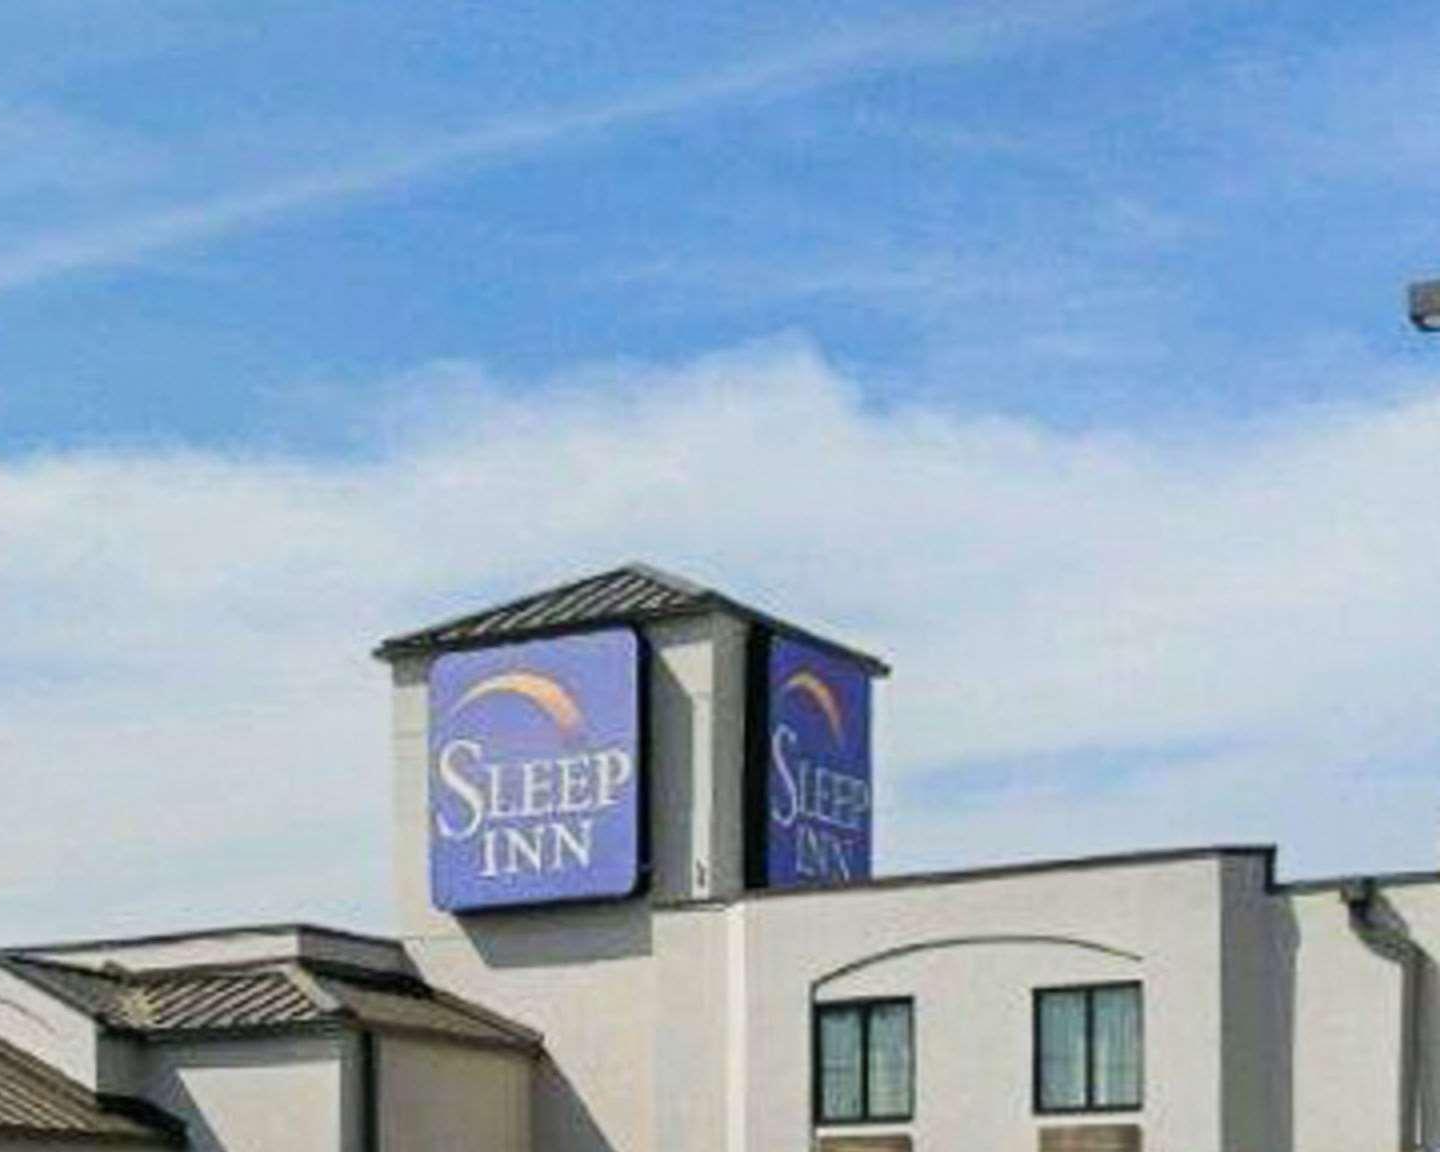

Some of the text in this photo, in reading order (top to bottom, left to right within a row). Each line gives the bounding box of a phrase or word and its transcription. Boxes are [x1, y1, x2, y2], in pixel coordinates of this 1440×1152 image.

[436, 739, 630, 838] SLEEP
[770, 724, 870, 829] SLEEP
[480, 820, 593, 877] INN
